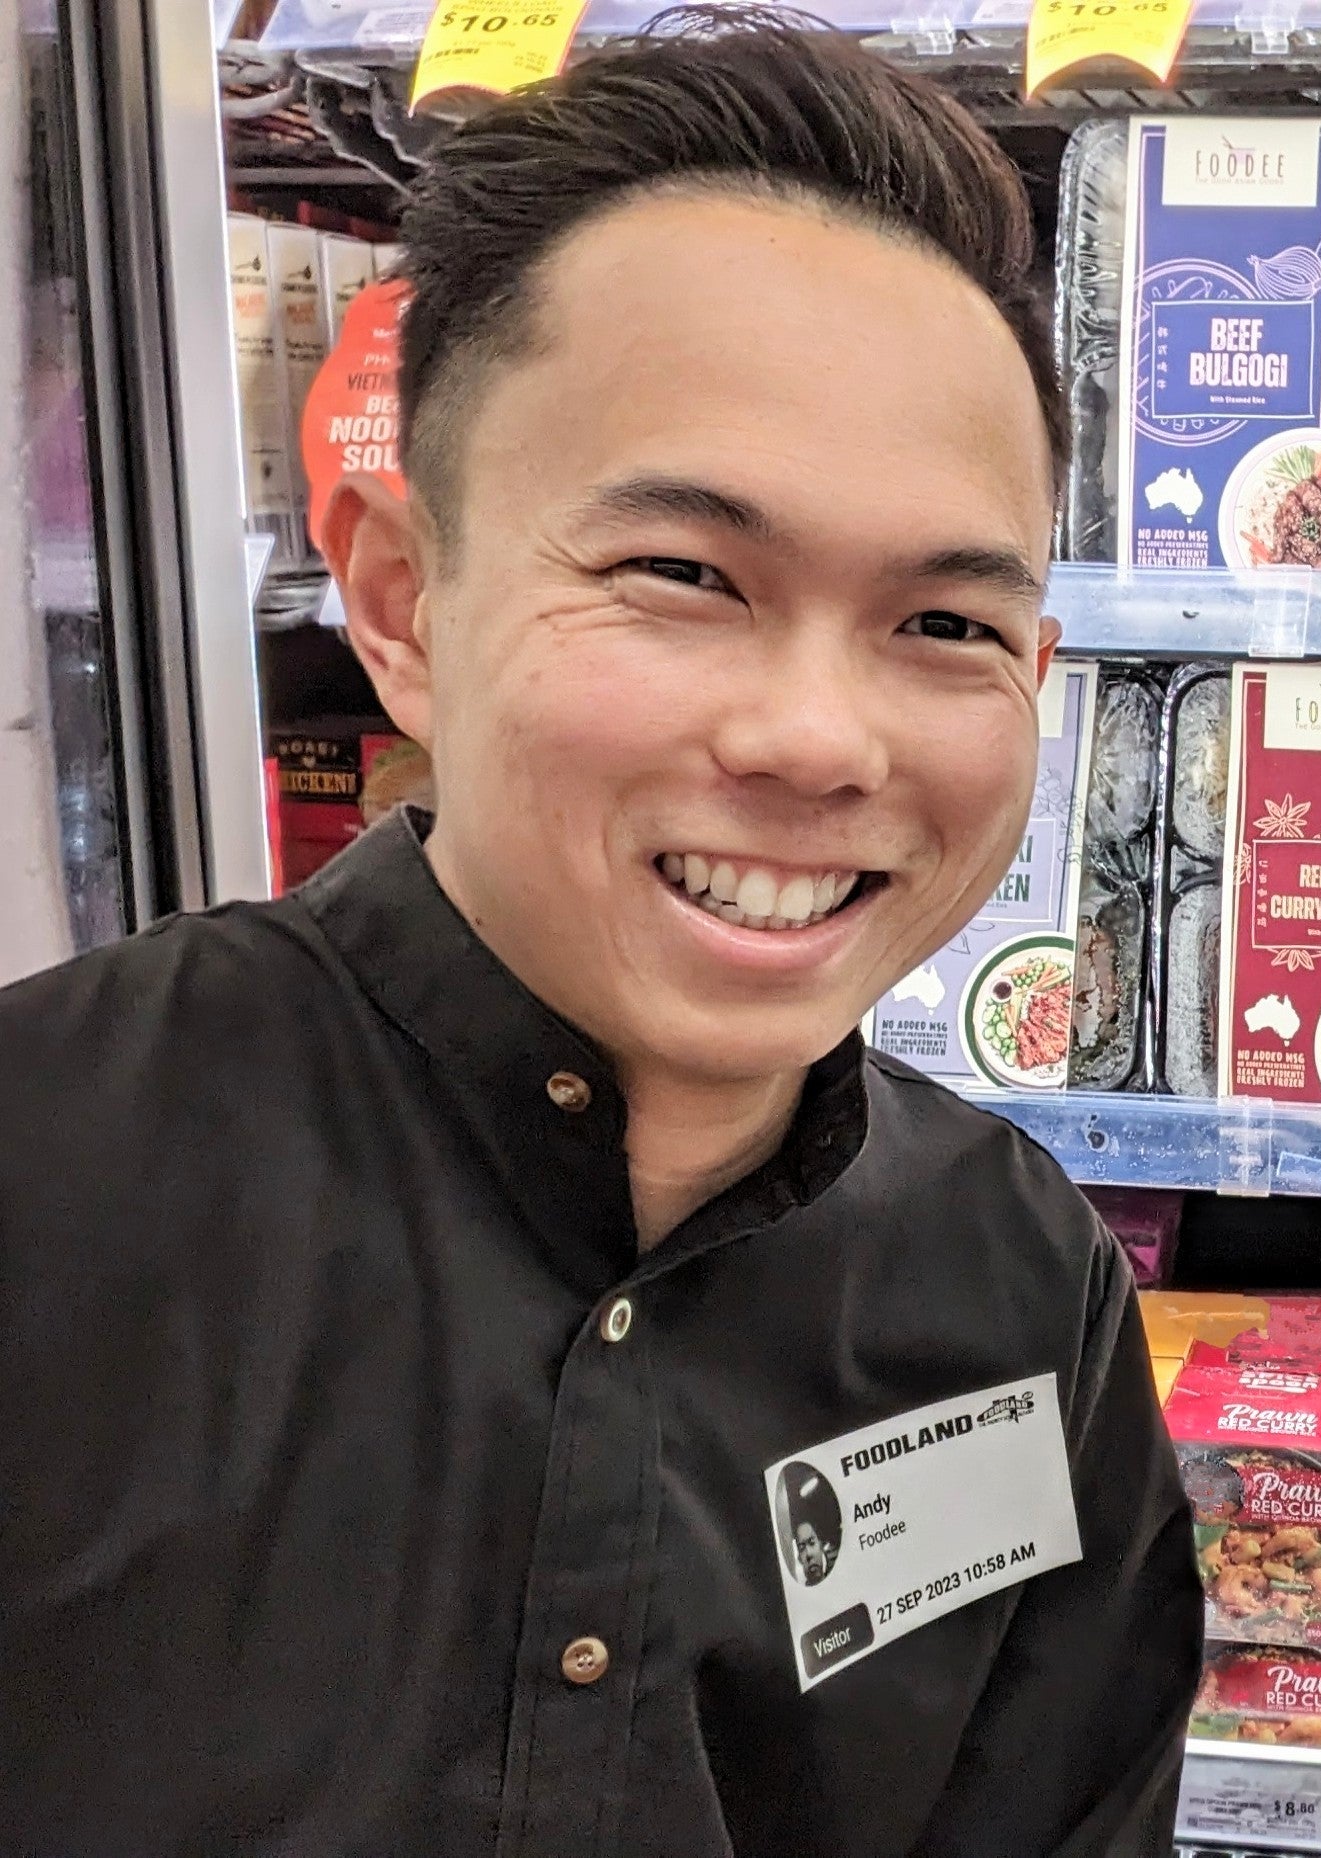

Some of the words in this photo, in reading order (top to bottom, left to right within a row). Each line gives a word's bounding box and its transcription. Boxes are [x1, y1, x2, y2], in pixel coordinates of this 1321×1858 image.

[1195, 149, 1284, 178] FOODEE
[1210, 318, 1264, 352] BEEF
[1189, 353, 1288, 388] BULGOGI
[1138, 528, 1151, 540] NO
[1154, 529, 1185, 541] ADDED
[1188, 530, 1208, 542] MSG
[882, 1020, 894, 1030] NO
[897, 1020, 926, 1030] ADDED
[929, 1021, 948, 1032] MSG
[1237, 1049, 1250, 1060] NO
[1252, 1050, 1283, 1062] ADDED
[1285, 1052, 1305, 1064] MSG
[1217, 1416, 1252, 1429] RED
[1256, 1420, 1318, 1433] CURRY
[1222, 1403, 1319, 1424] Prawn
[840, 1414, 973, 1477] FOODLAND
[854, 1493, 891, 1523] Andy
[1251, 1499, 1283, 1514] RED
[859, 1521, 907, 1551] Foodee
[877, 1602, 893, 1625] 27
[896, 1590, 922, 1614] SEP
[925, 1572, 961, 1601] 2023
[964, 1554, 1006, 1583] 10:58
[1010, 1542, 1036, 1566] AM
[813, 1626, 851, 1658] Visitor
[1266, 1691, 1297, 1706] RED
